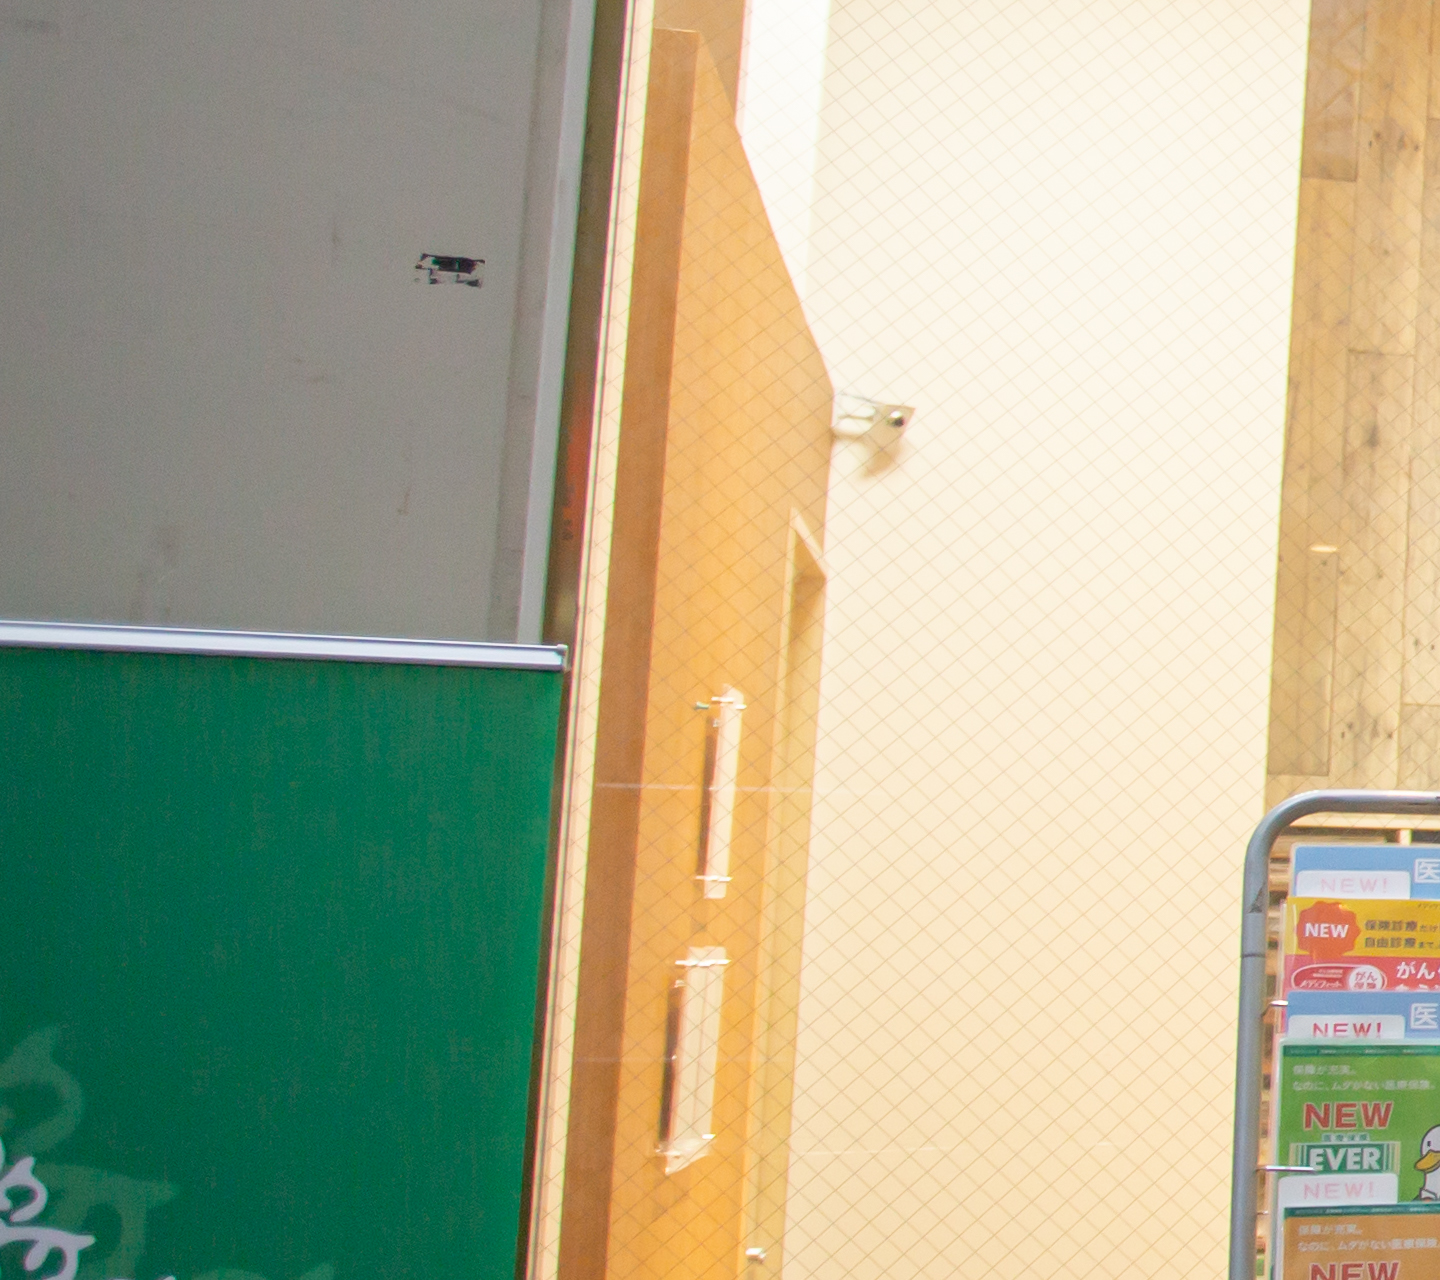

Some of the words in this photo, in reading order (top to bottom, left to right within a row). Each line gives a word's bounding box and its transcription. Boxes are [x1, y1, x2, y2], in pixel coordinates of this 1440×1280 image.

[1320, 877, 1388, 893] NEW!
[1305, 922, 1348, 938] NEW
[1312, 1022, 1382, 1038] NEW!
[1304, 1101, 1392, 1130] NEW
[1309, 1147, 1381, 1172] EVER
[1303, 1182, 1375, 1199] NEW!
